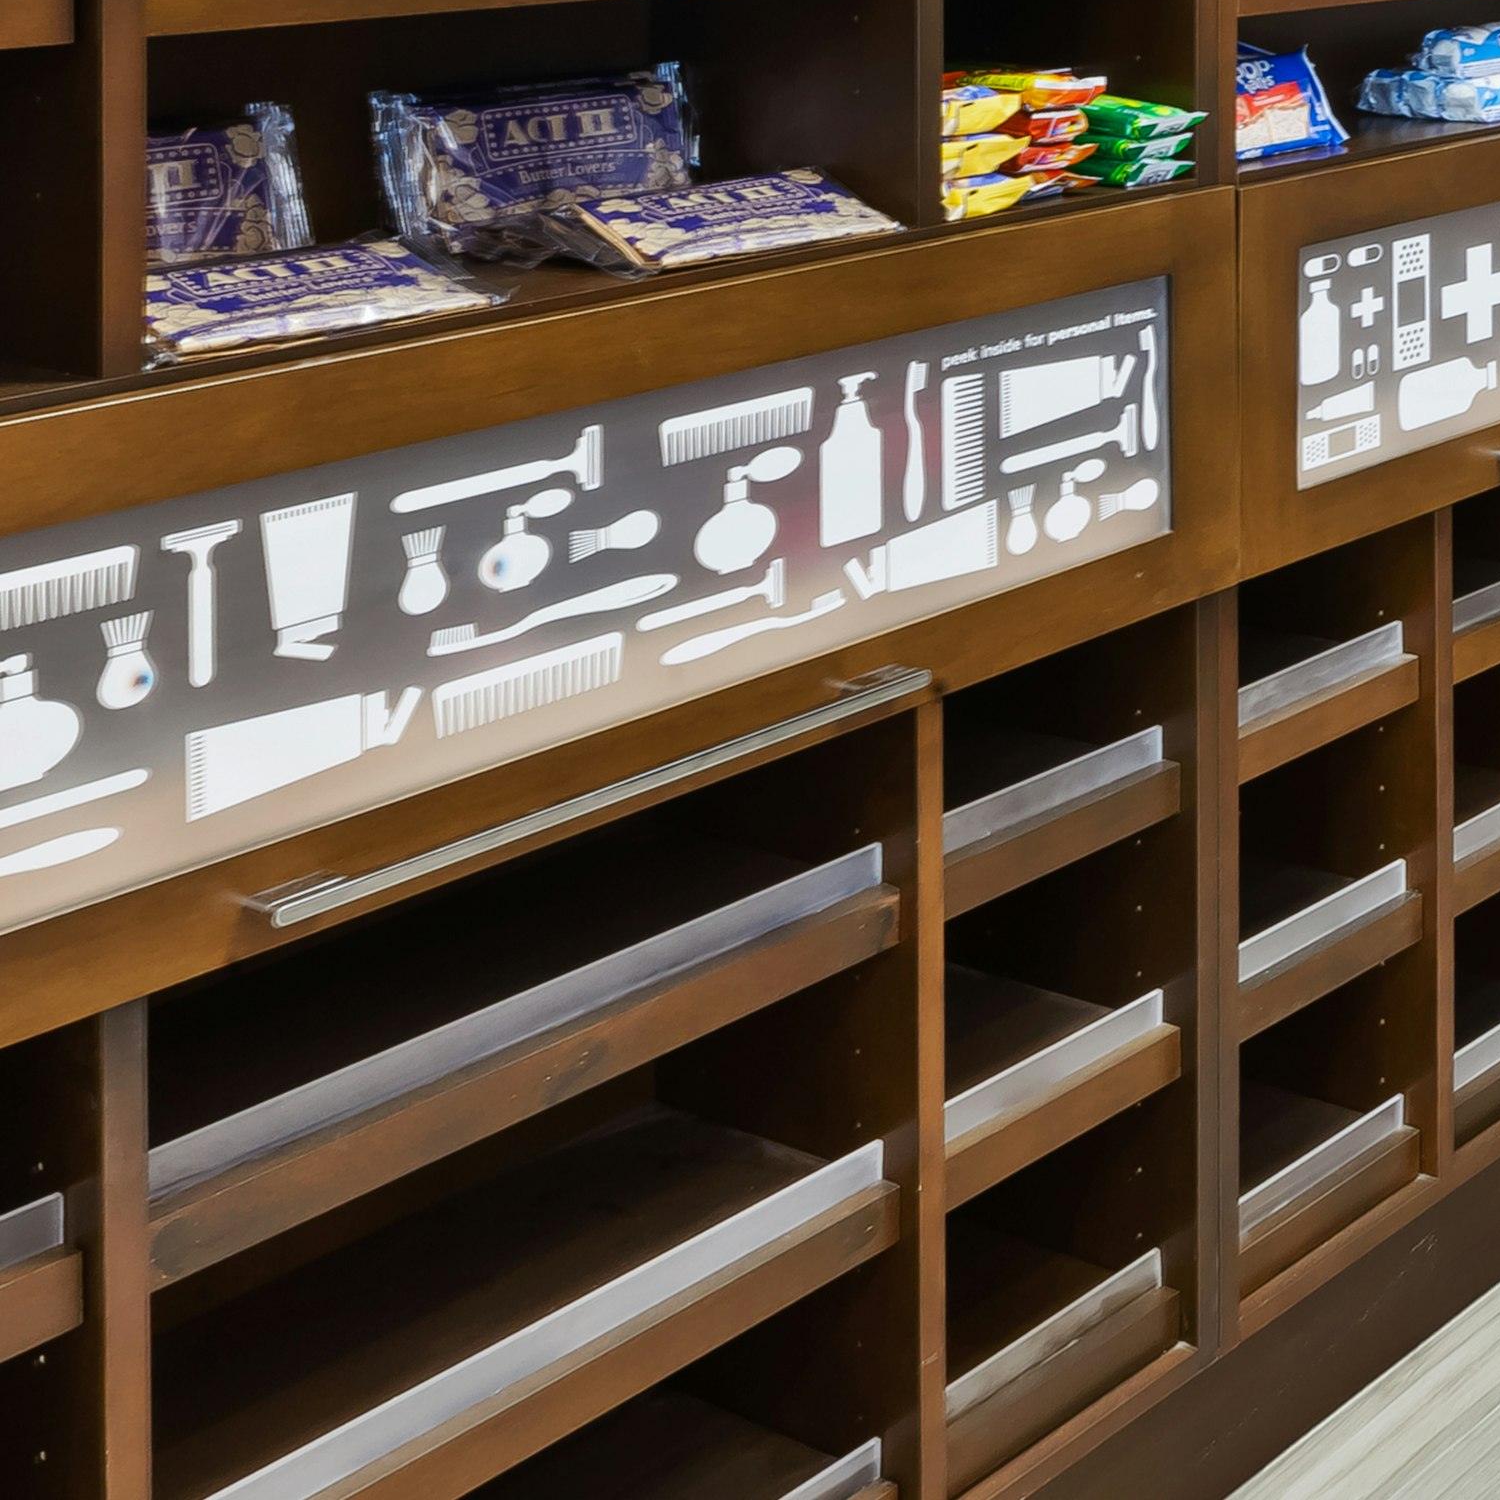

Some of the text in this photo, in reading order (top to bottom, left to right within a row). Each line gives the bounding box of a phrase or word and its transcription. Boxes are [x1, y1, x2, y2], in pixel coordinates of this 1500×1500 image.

[504, 107, 618, 149] ACT II
[518, 159, 617, 187] Butter Lovers
[147, 220, 199, 235] overs
[204, 261, 297, 288] ACT
[941, 349, 979, 371] peek
[980, 338, 1023, 359] inside
[1023, 332, 1046, 349] for
[1047, 315, 1112, 346] personal
